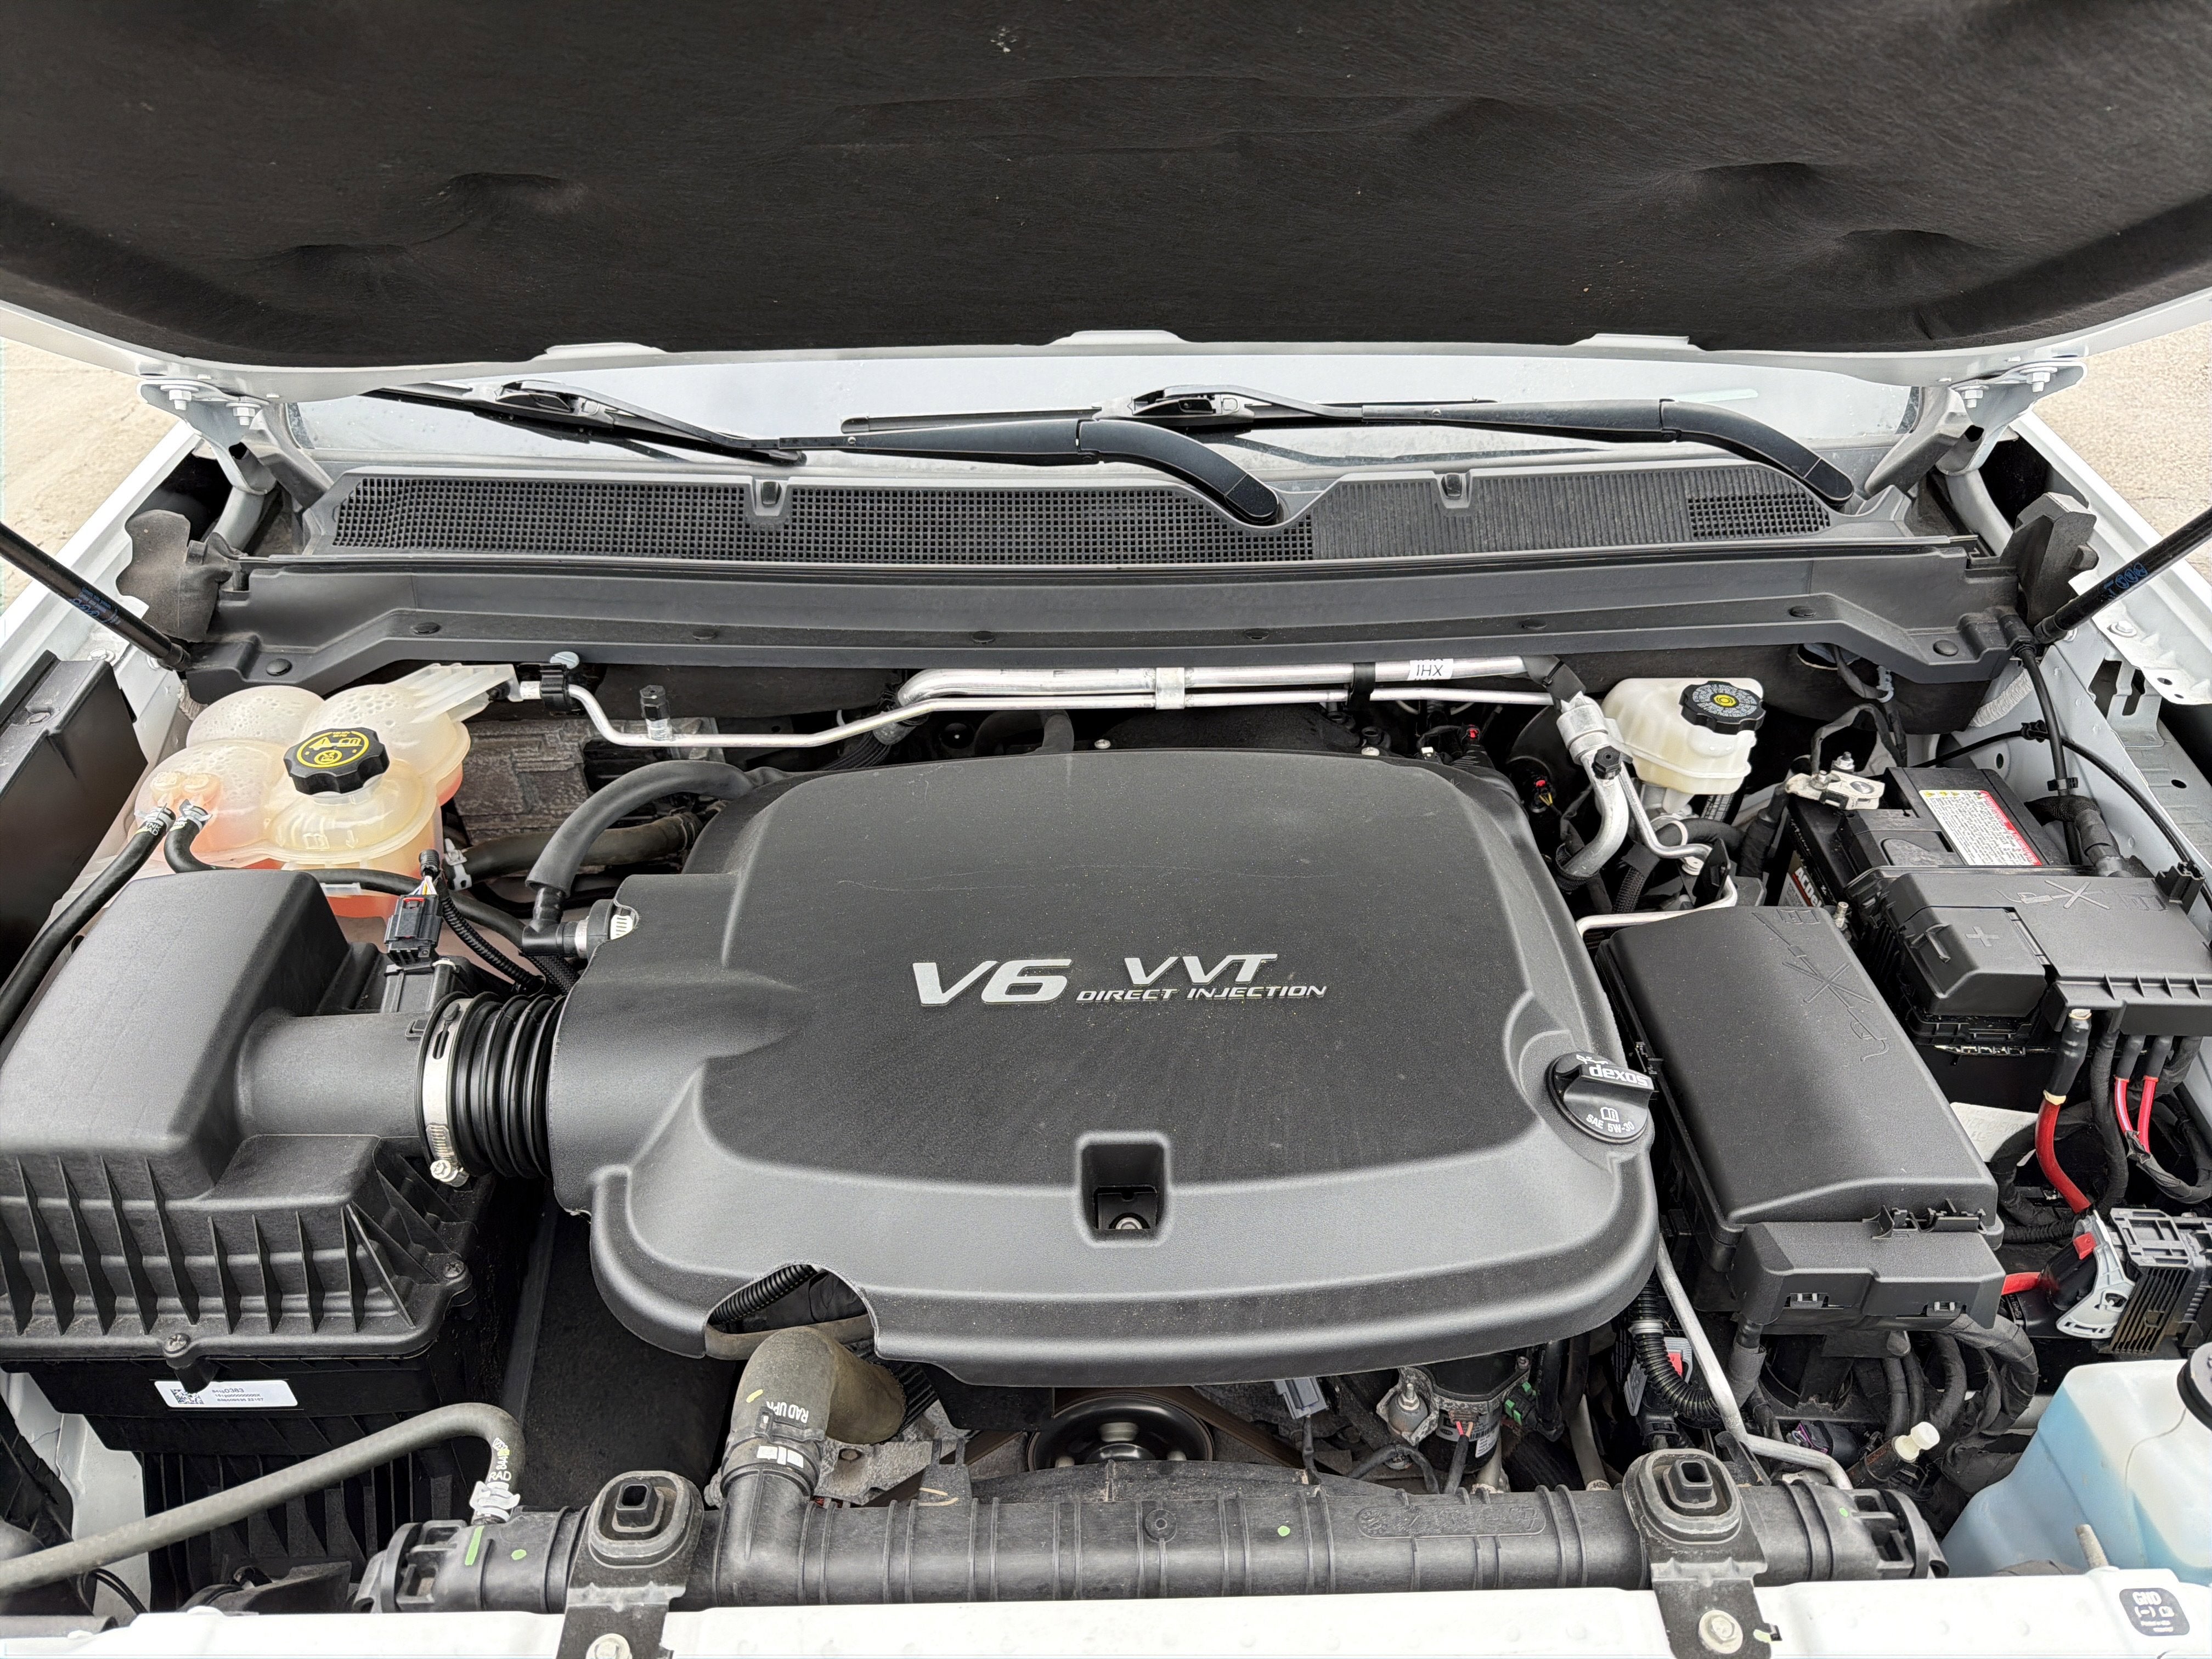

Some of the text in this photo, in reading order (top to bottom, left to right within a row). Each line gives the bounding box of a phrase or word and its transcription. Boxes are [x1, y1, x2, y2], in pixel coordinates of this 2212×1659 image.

[1124, 953, 1278, 985] VVT
[912, 958, 1074, 1006] V6
[1075, 985, 1328, 1003] DIRECT INJECTION
[1589, 1064, 1648, 1087] dexos
[1585, 1114, 1635, 1133] SAE 5W-30
[788, 1404, 809, 1424] RAD
[488, 1470, 512, 1482] RAD
[2132, 1591, 2162, 1606] GND
